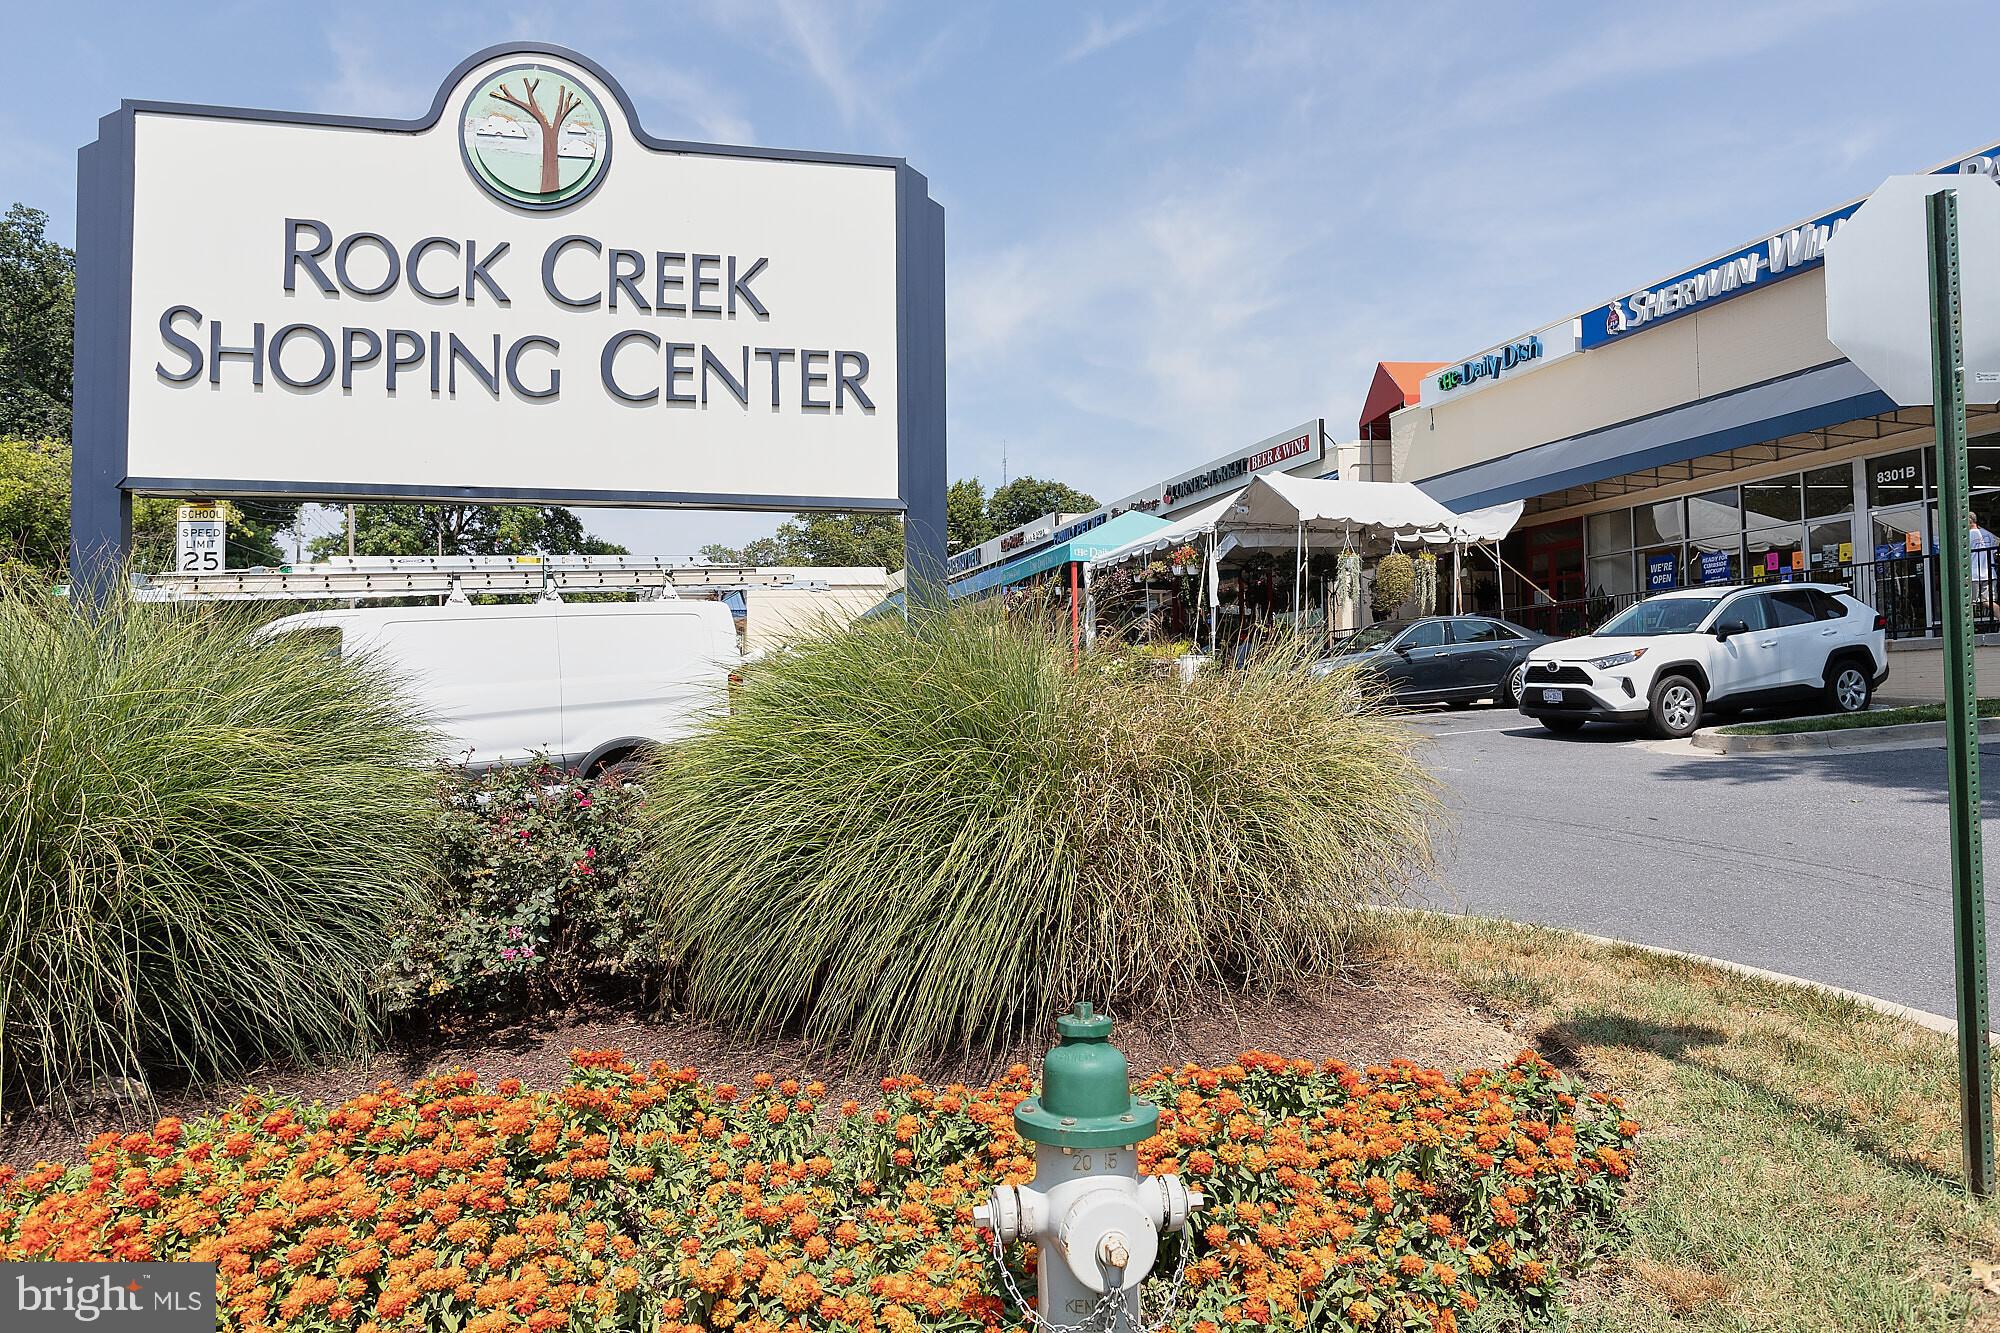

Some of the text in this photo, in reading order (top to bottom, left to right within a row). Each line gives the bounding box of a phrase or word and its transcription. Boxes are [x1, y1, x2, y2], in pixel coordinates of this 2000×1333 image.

[283, 218, 770, 319] ROCK CREEK
[155, 304, 877, 414] SHOPPING CENTER
[1461, 355, 1502, 385] Daily
[1501, 335, 1544, 370] Dish
[1252, 451, 1273, 471] BEER
[1274, 446, 1282, 461] &
[1282, 436, 1307, 459] WINE
[1877, 466, 1916, 483] 8301B
[182, 510, 221, 519] SCHOOL
[183, 528, 221, 537] SPEED
[186, 540, 216, 549] LIMIT
[184, 551, 219, 571] 25
[1650, 561, 1673, 574] WE'RE
[1652, 573, 1672, 585] OPEN
[1072, 1154, 1092, 1171] 20
